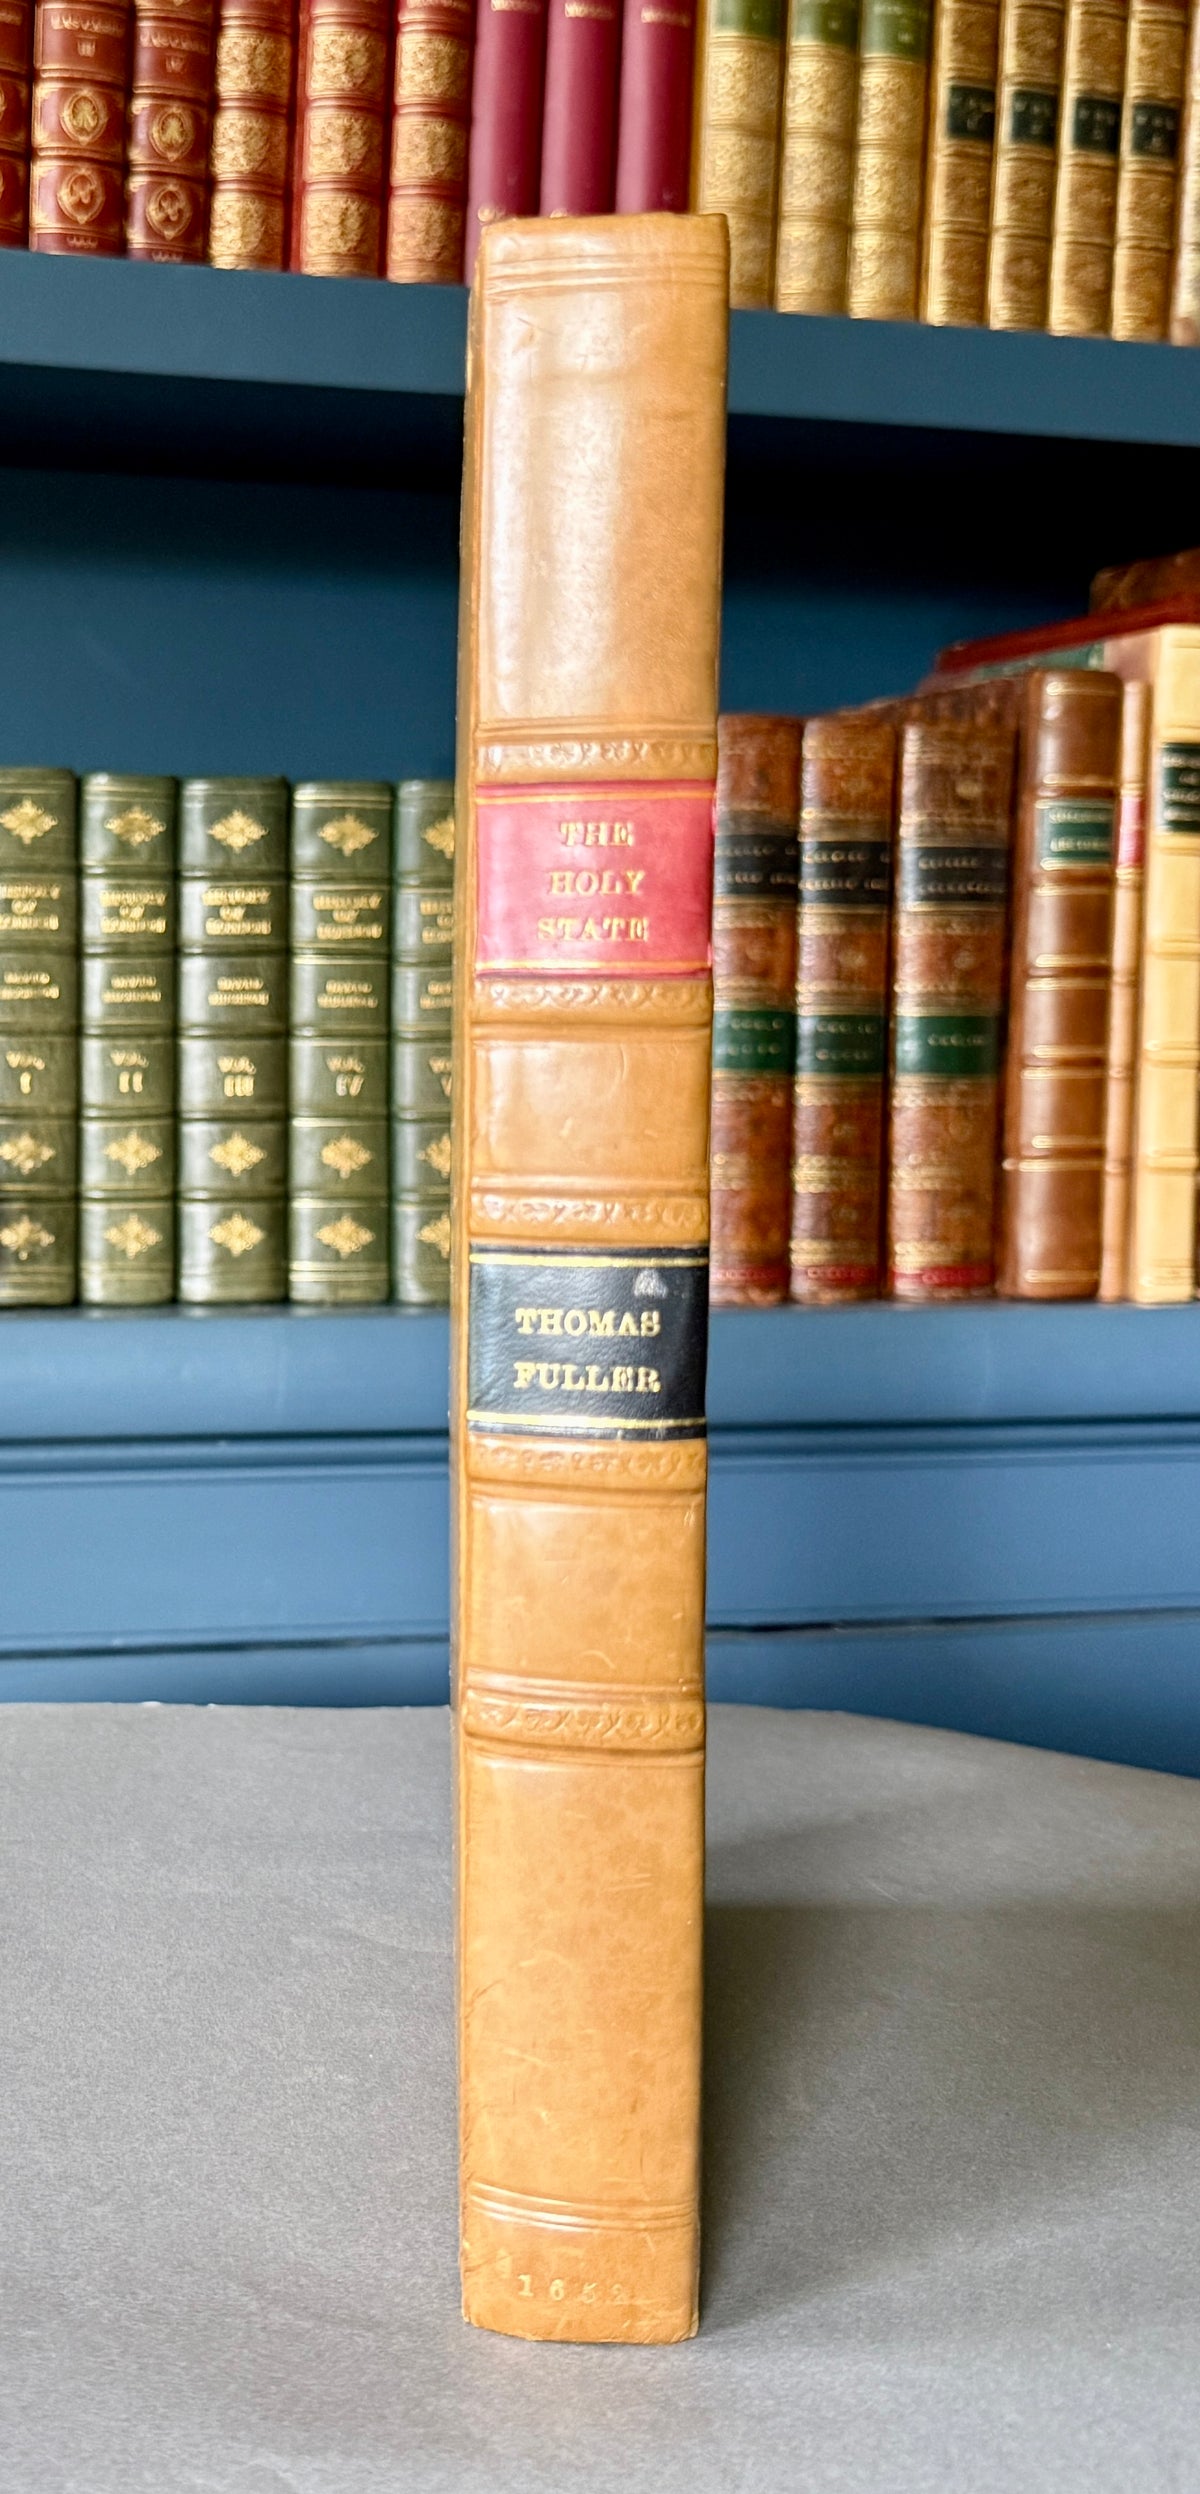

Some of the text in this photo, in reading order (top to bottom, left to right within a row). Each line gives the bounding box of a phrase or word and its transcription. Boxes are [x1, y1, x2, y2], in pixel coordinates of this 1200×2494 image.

[560, 821, 635, 848] THE
[548, 869, 646, 897] HOLY
[537, 916, 650, 943] STATE
[514, 1307, 662, 1338] THOMAS
[512, 1361, 662, 1393] FULLER
